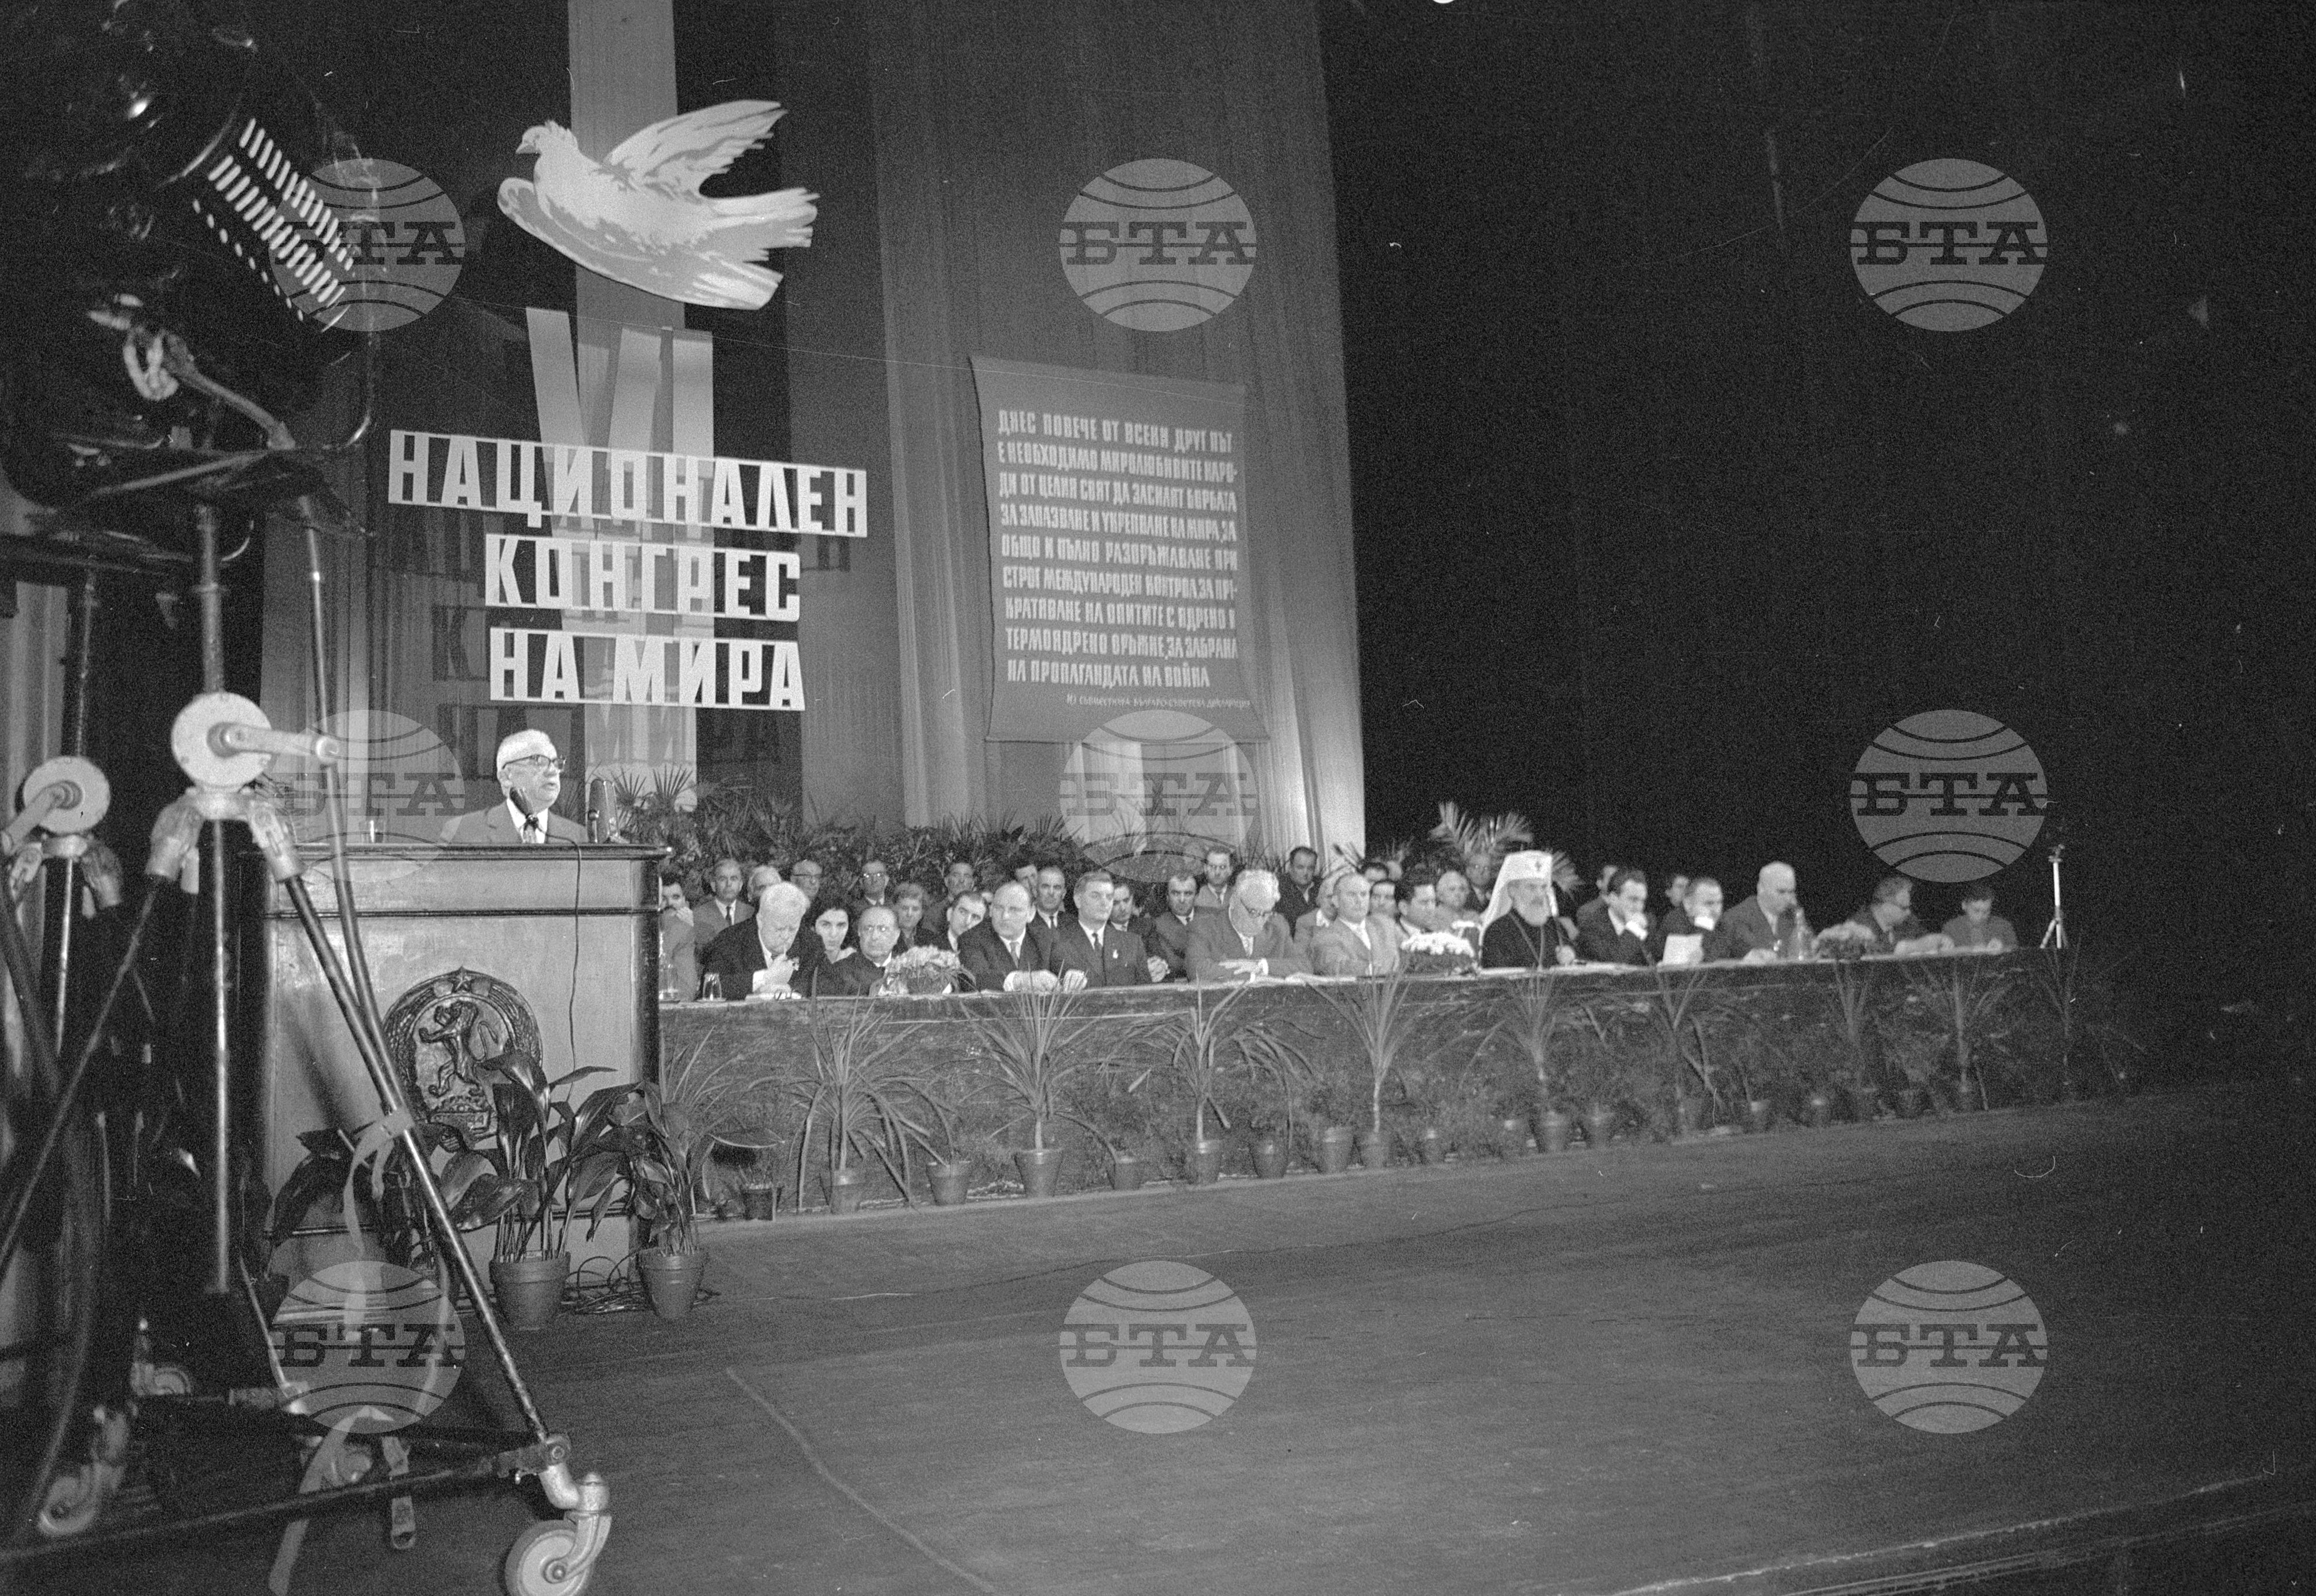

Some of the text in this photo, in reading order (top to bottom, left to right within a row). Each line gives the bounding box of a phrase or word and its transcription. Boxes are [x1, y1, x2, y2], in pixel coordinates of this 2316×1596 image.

[998, 410, 1232, 453] ДНЕС ПОВЕЧЕ ОТ ВСЕКИ ДРУГ ПЪТ
[998, 442, 1005, 464] Е
[1007, 442, 1098, 471] НЕОБХОДИМО
[389, 430, 867, 537] НАЦИОНАЛЕН
[999, 472, 1017, 498] ДИ
[1020, 474, 1036, 495] ОТ
[1039, 475, 1078, 499] ЦЕЛИЯ
[1080, 479, 1110, 502] СВЯТ
[1113, 482, 1129, 505] ДА
[1188, 488, 1237, 512] БОРБАТА
[1001, 504, 1018, 526] ЗА
[1020, 505, 1090, 531] ЗАПАЗВАНЕ
[1091, 511, 1100, 532] И
[1101, 512, 1169, 538] УКРЕПВАНЕ
[1171, 516, 1186, 539] НА
[1002, 534, 1237, 571] ОБЩО И ПЪЛНО РАЗОРЪЖАВАНЕ ПРИ
[485, 534, 800, 621] КОНГРЕС
[1003, 566, 1040, 589] СТРОГ
[1044, 567, 1142, 597] МЕЖДУНАРОДЕН
[1005, 597, 1081, 622] КРАТЯВАНЕ
[1085, 603, 1104, 623] НА
[1106, 603, 1163, 626] ОПИТИТЕ
[1166, 606, 1174, 628] С
[1178, 607, 1226, 631] ЯДРЕНО
[1005, 628, 1108, 655] ТЕРМОЯДРЕНО
[1166, 637, 1184, 658] ЗА
[1185, 637, 1238, 659] ЗАБРАНА
[490, 627, 805, 711] НА МИРА
[1007, 659, 1210, 689] НА ПРОПАГАНДАТА НА ВОЙНА
